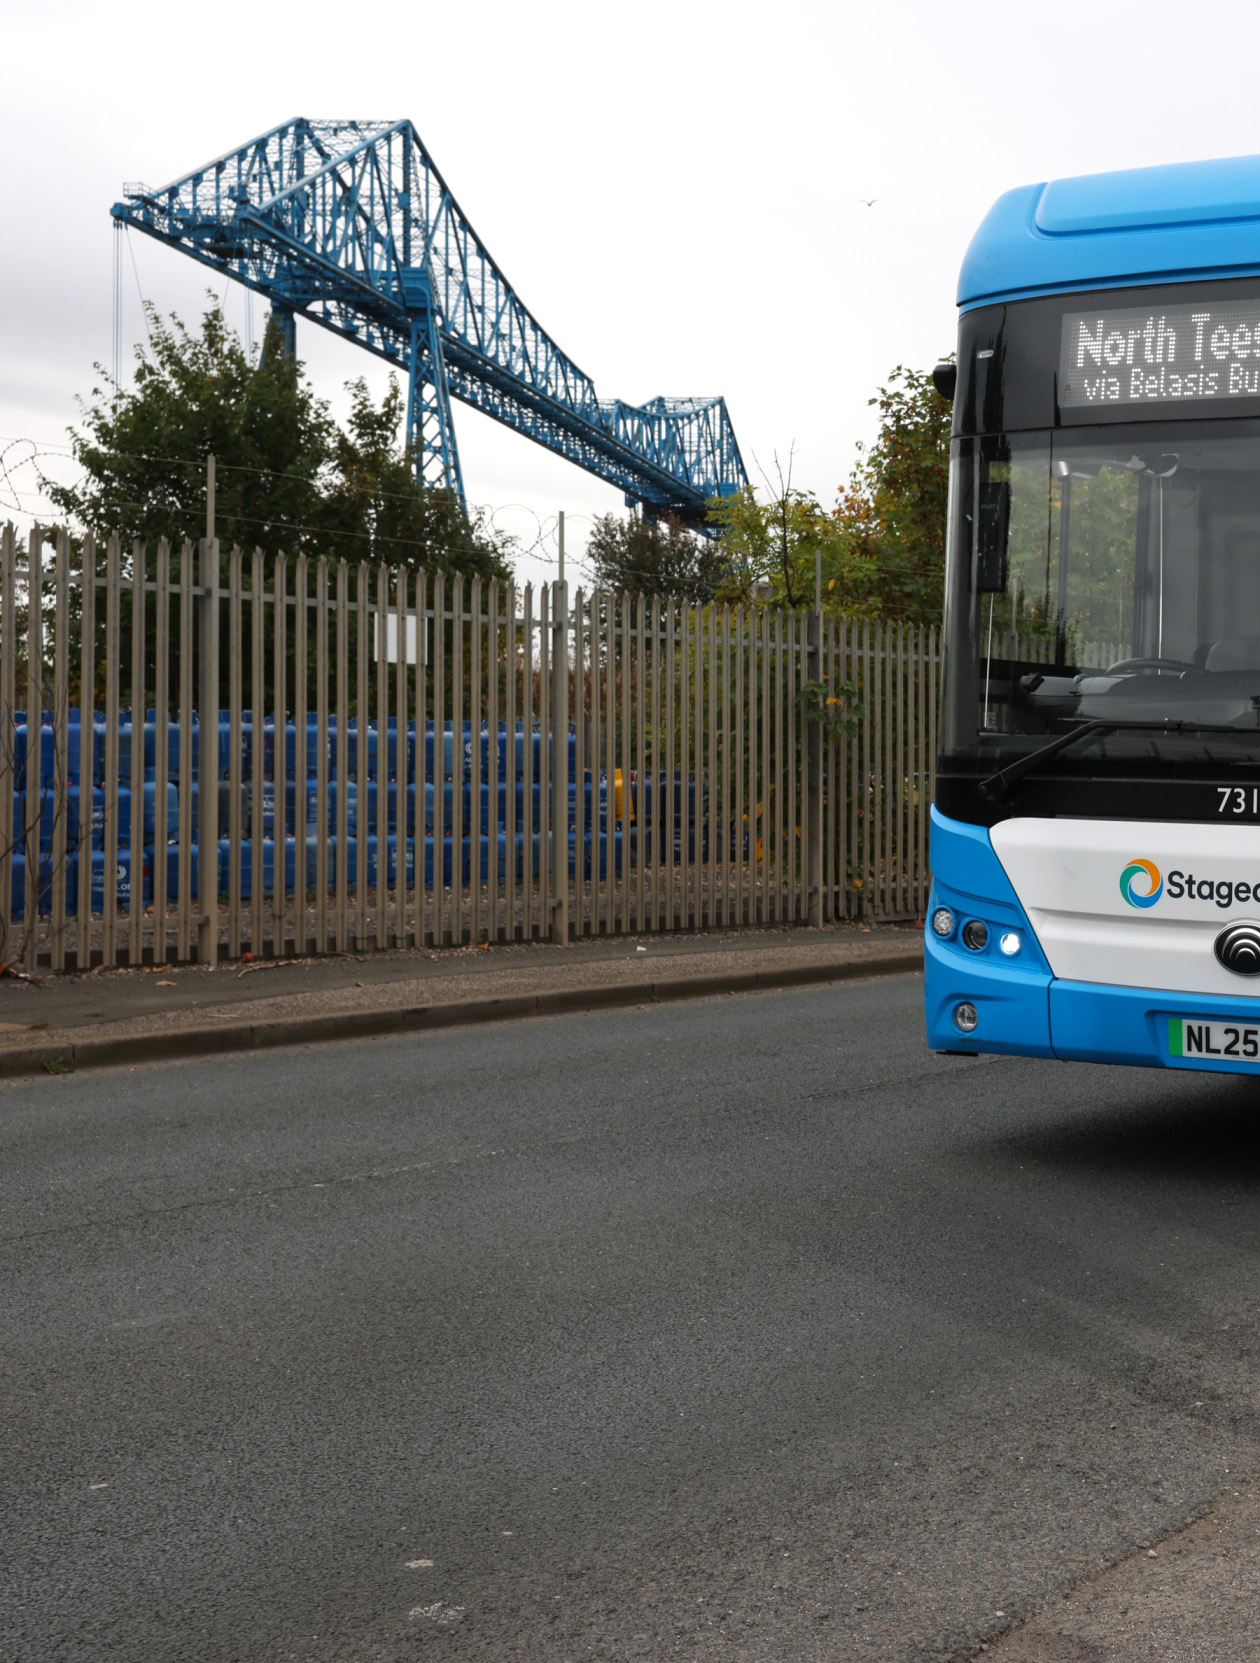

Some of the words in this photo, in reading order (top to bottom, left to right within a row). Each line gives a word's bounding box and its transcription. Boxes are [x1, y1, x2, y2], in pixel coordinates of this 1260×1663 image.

[1076, 316, 1176, 367] North
[1084, 370, 1120, 400] via
[1130, 366, 1218, 399] Belasis
[1186, 1025, 1259, 1058] NL25
